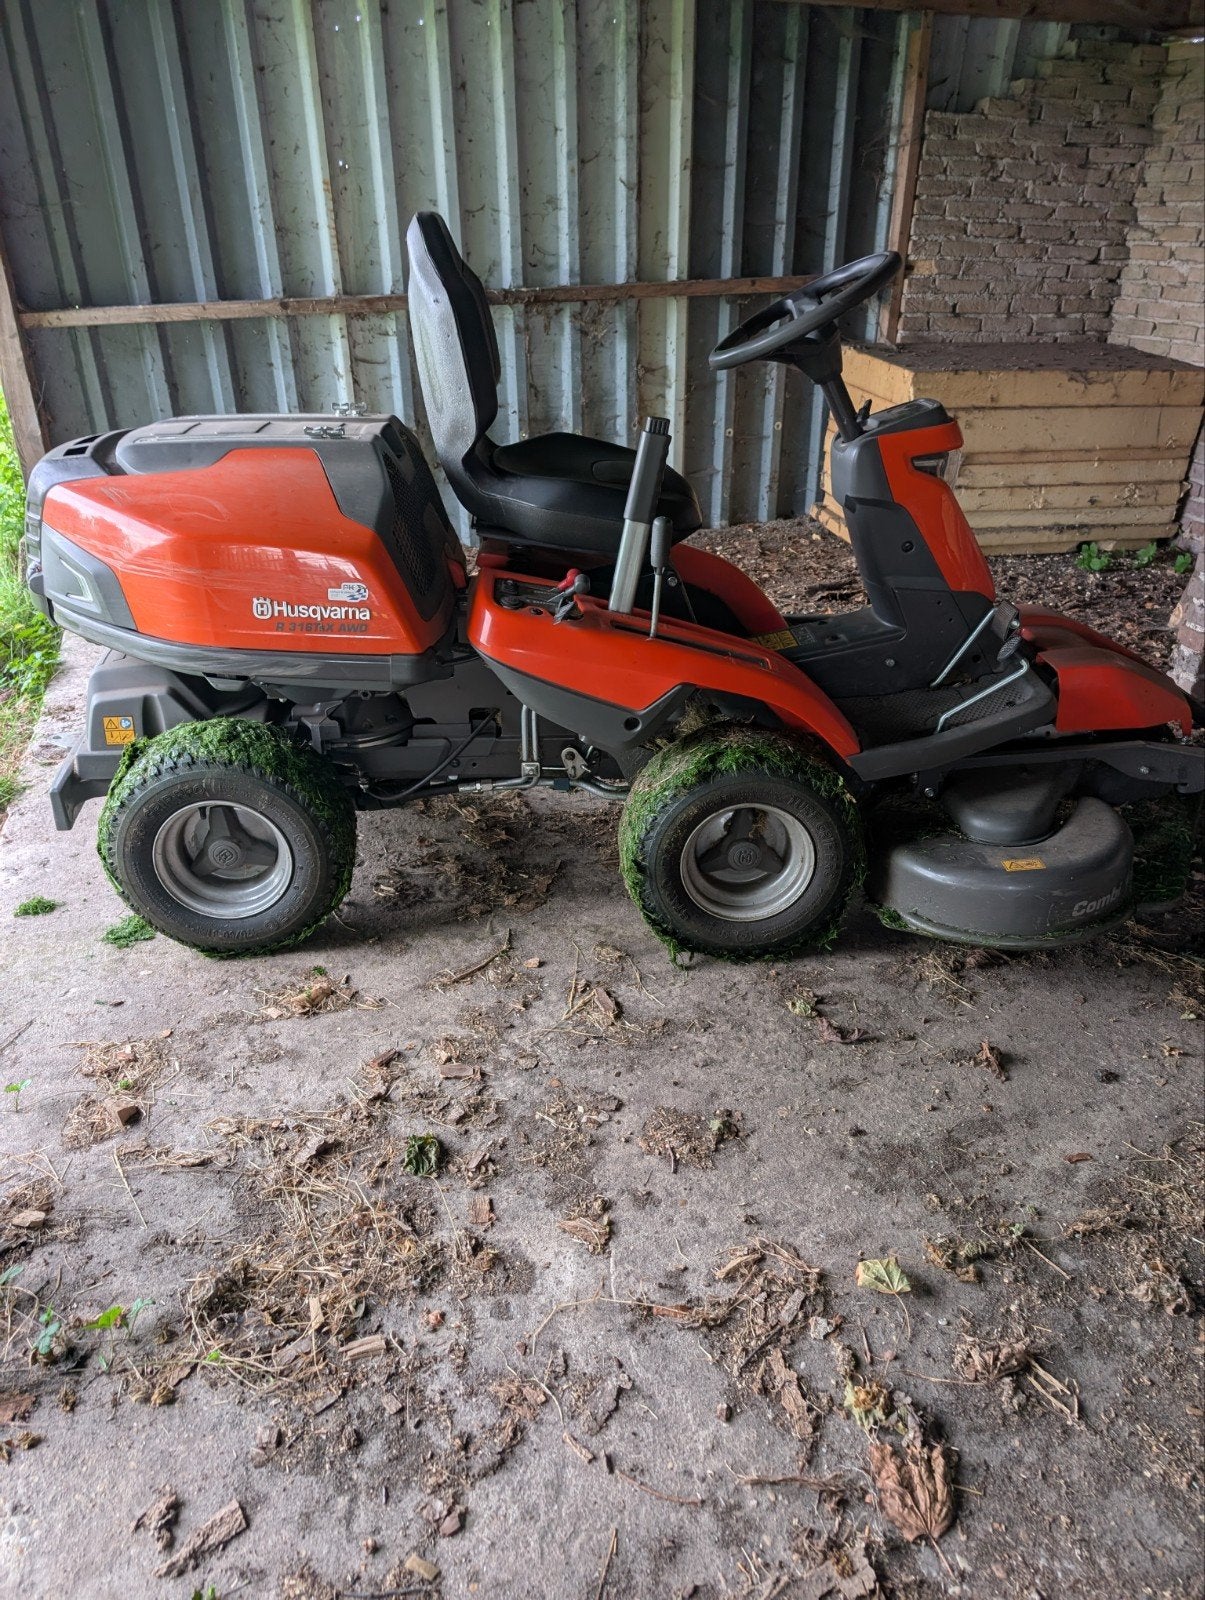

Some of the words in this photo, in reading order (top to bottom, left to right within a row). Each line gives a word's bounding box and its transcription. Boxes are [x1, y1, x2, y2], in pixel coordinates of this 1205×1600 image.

[273, 600, 370, 621] Husqvarna
[275, 621, 285, 632] R
[338, 623, 369, 633] AWD
